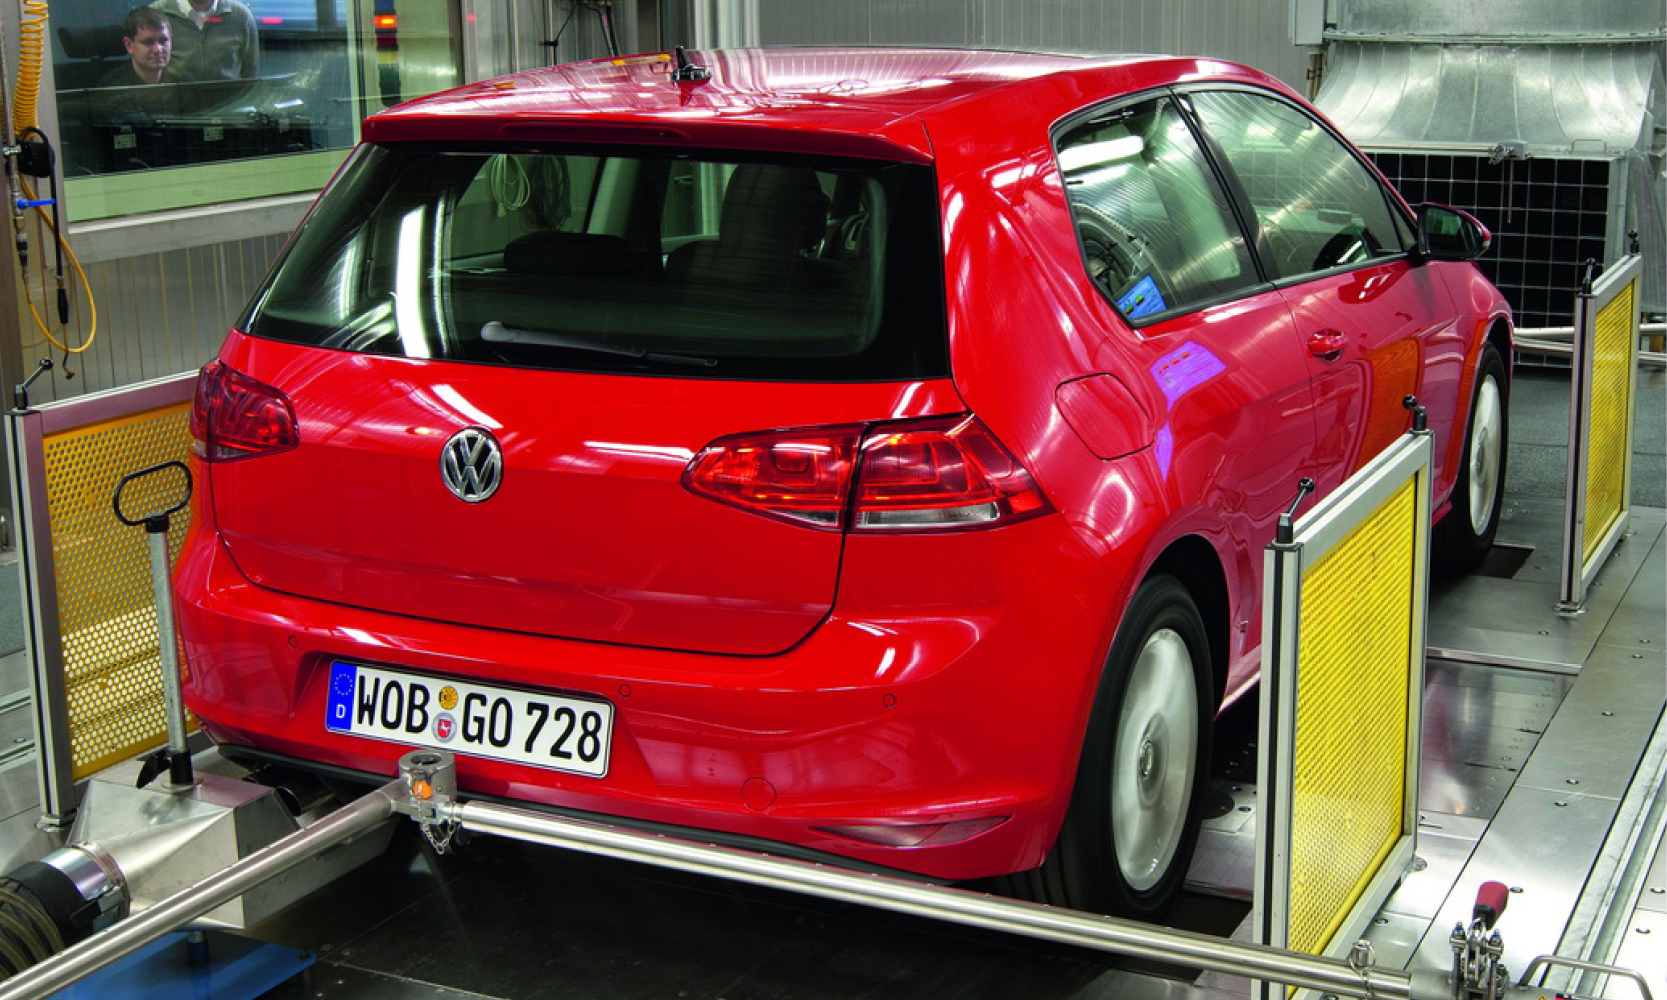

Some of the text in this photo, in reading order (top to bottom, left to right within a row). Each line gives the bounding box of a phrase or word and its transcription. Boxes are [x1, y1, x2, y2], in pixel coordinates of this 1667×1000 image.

[440, 428, 502, 502] VW
[335, 704, 347, 718] D
[357, 675, 603, 762] WOB GO 728
